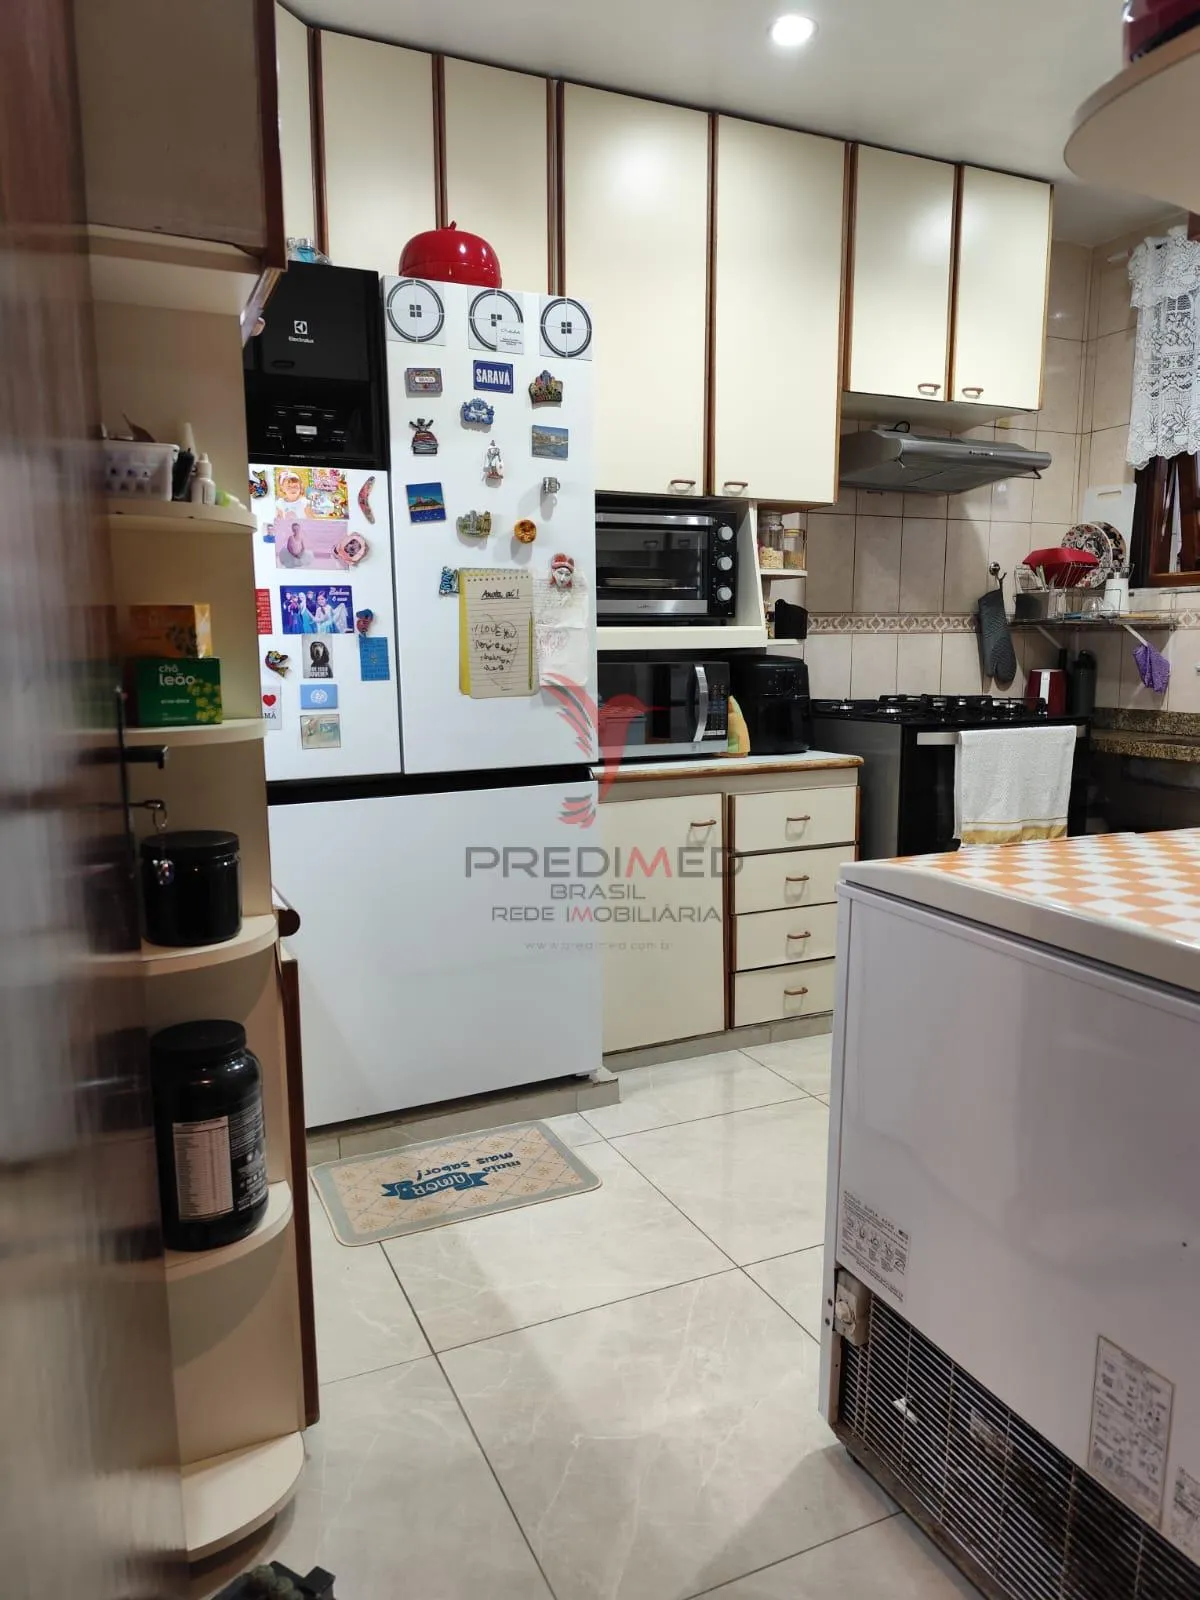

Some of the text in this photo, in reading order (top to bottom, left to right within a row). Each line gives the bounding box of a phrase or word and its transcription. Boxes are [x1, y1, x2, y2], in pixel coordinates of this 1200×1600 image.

[160, 673, 195, 686] leão
[416, 1151, 513, 1181] mais sabor!
